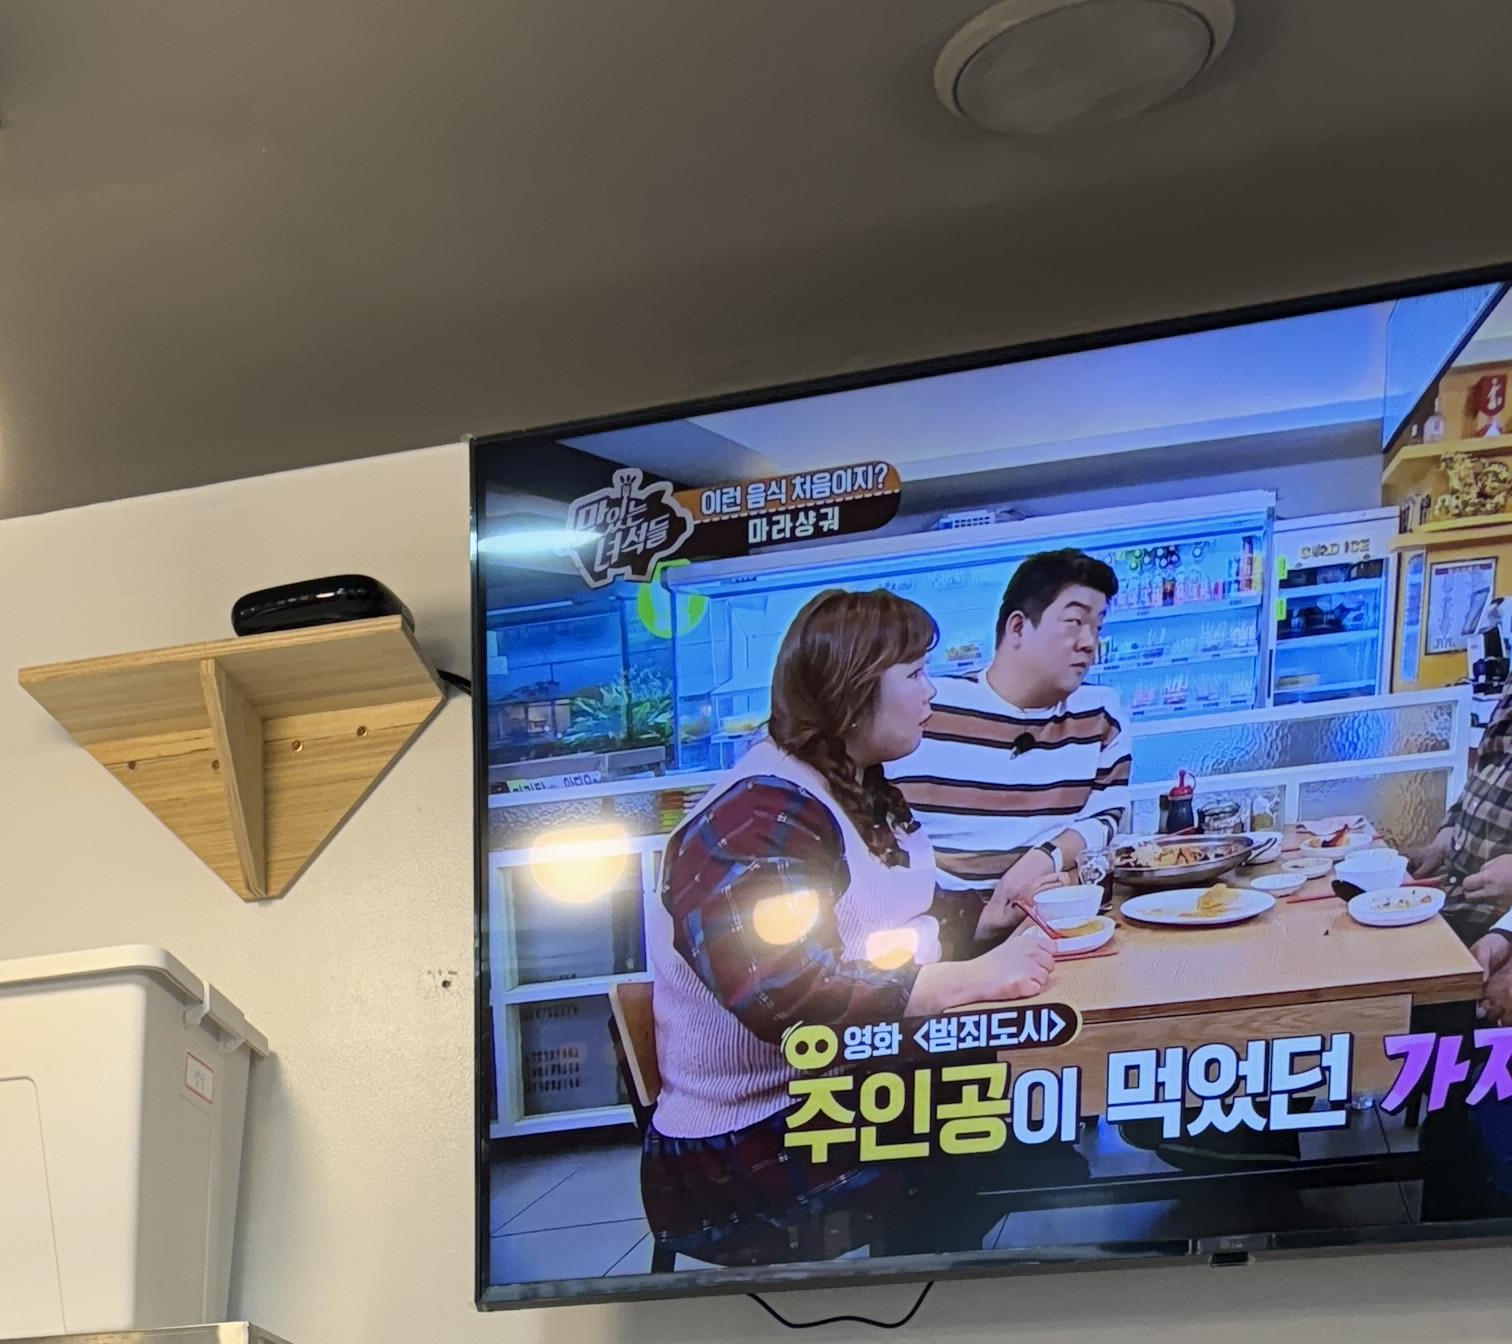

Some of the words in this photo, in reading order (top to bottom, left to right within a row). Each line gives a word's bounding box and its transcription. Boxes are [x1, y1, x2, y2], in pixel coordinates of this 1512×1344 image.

[700, 486, 743, 516] 이런
[745, 482, 787, 510] 음식
[789, 462, 890, 506] 처음이지?
[594, 513, 671, 573] 녀석들
[748, 506, 840, 544] 마라샹궈
[843, 1022, 903, 1061] 영화
[913, 1008, 1066, 1053] <범죄도시>
[784, 1063, 1079, 1164] 주인공이
[1106, 1032, 1353, 1140] 먹었던
